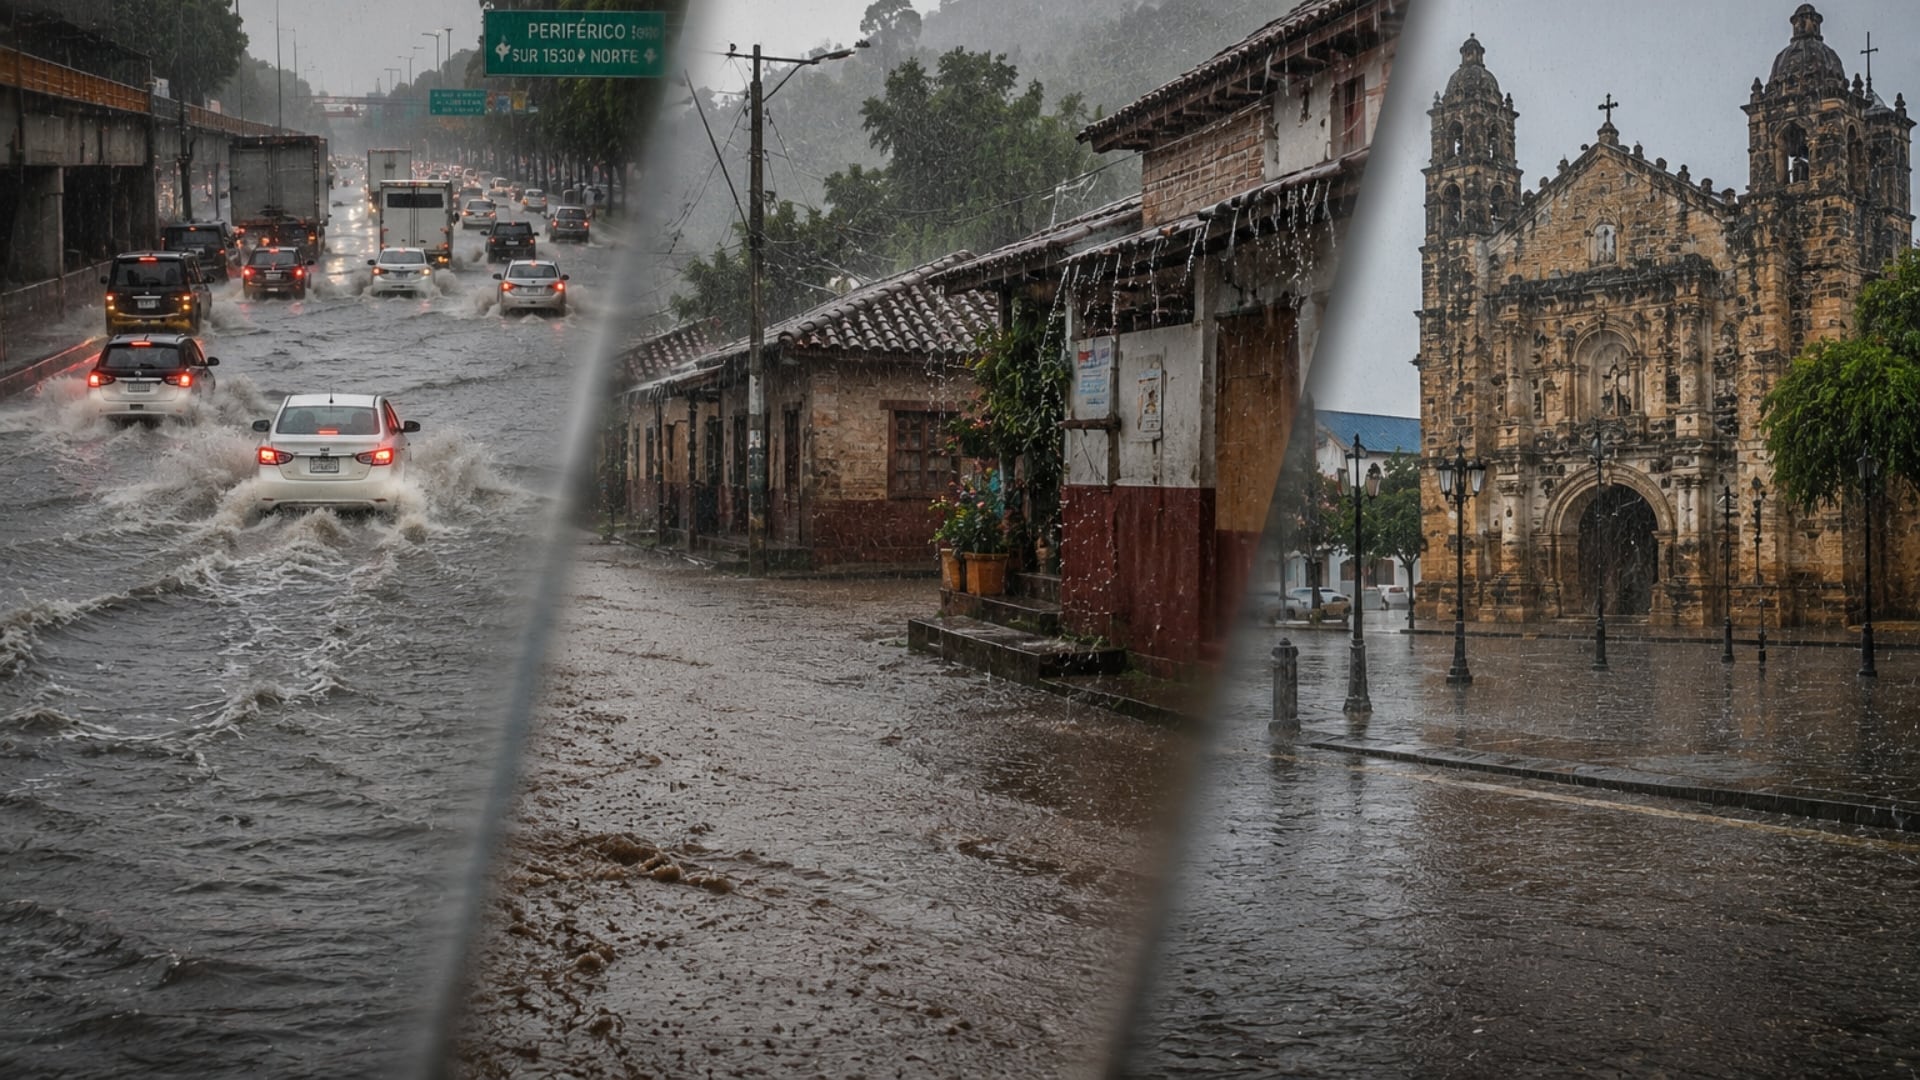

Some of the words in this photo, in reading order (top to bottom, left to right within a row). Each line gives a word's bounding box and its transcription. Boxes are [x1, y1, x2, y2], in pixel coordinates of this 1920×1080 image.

[528, 18, 626, 40] PERIFÉRICO
[512, 48, 538, 63] SUR
[590, 48, 639, 64] NORTE
